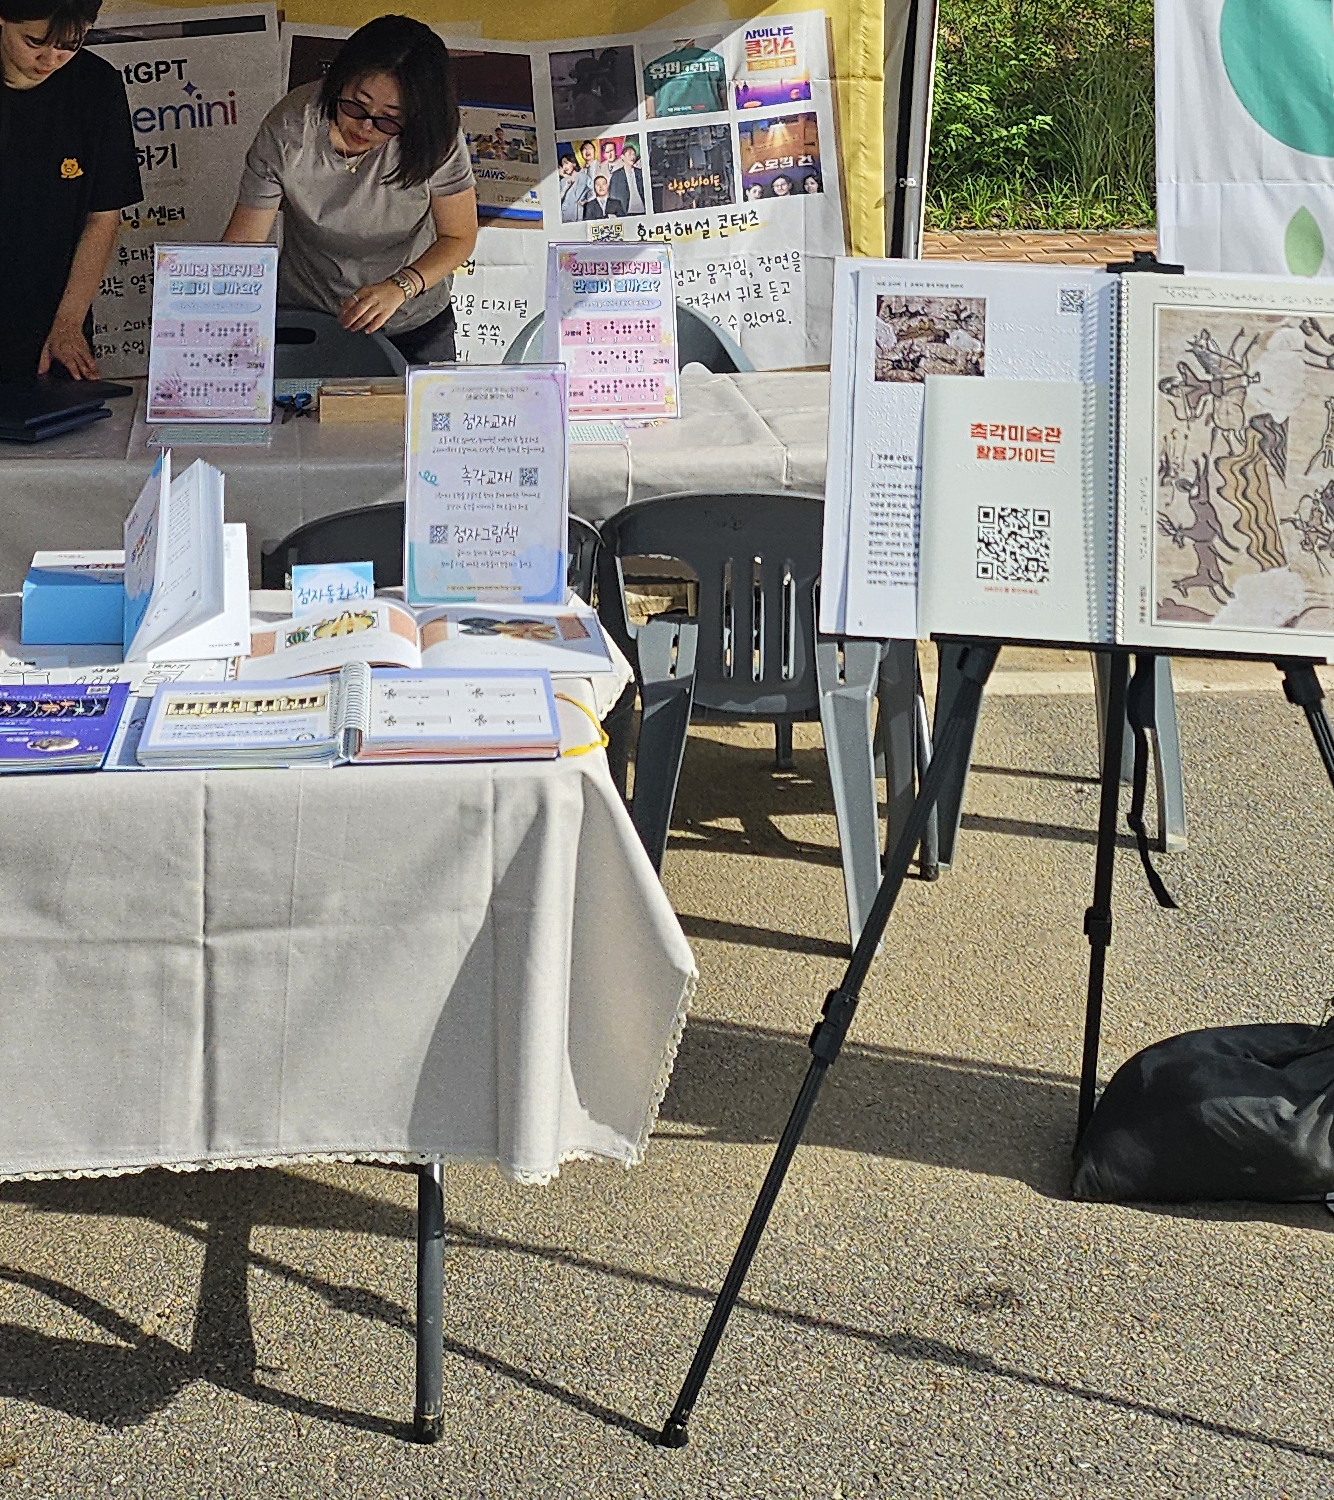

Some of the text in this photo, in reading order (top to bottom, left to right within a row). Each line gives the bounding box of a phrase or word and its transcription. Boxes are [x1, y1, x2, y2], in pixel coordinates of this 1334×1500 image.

[132, 90, 238, 133] emini
[147, 206, 186, 227] 센터
[637, 209, 760, 243] 화면해설 콘텐츠
[706, 260, 754, 285] 움직임,
[757, 250, 802, 274] 장면을
[736, 284, 764, 303] 귀로
[769, 280, 792, 302] 듣고
[481, 299, 527, 318] 디지털
[728, 314, 738, 330] 수
[743, 309, 792, 329] 있어요.
[463, 412, 517, 430] 점자교재
[970, 422, 1062, 444] 촉각미술관
[462, 464, 513, 487] 촉각교재
[453, 521, 519, 543] 점자그림책
[297, 581, 369, 606] 점자동화책
